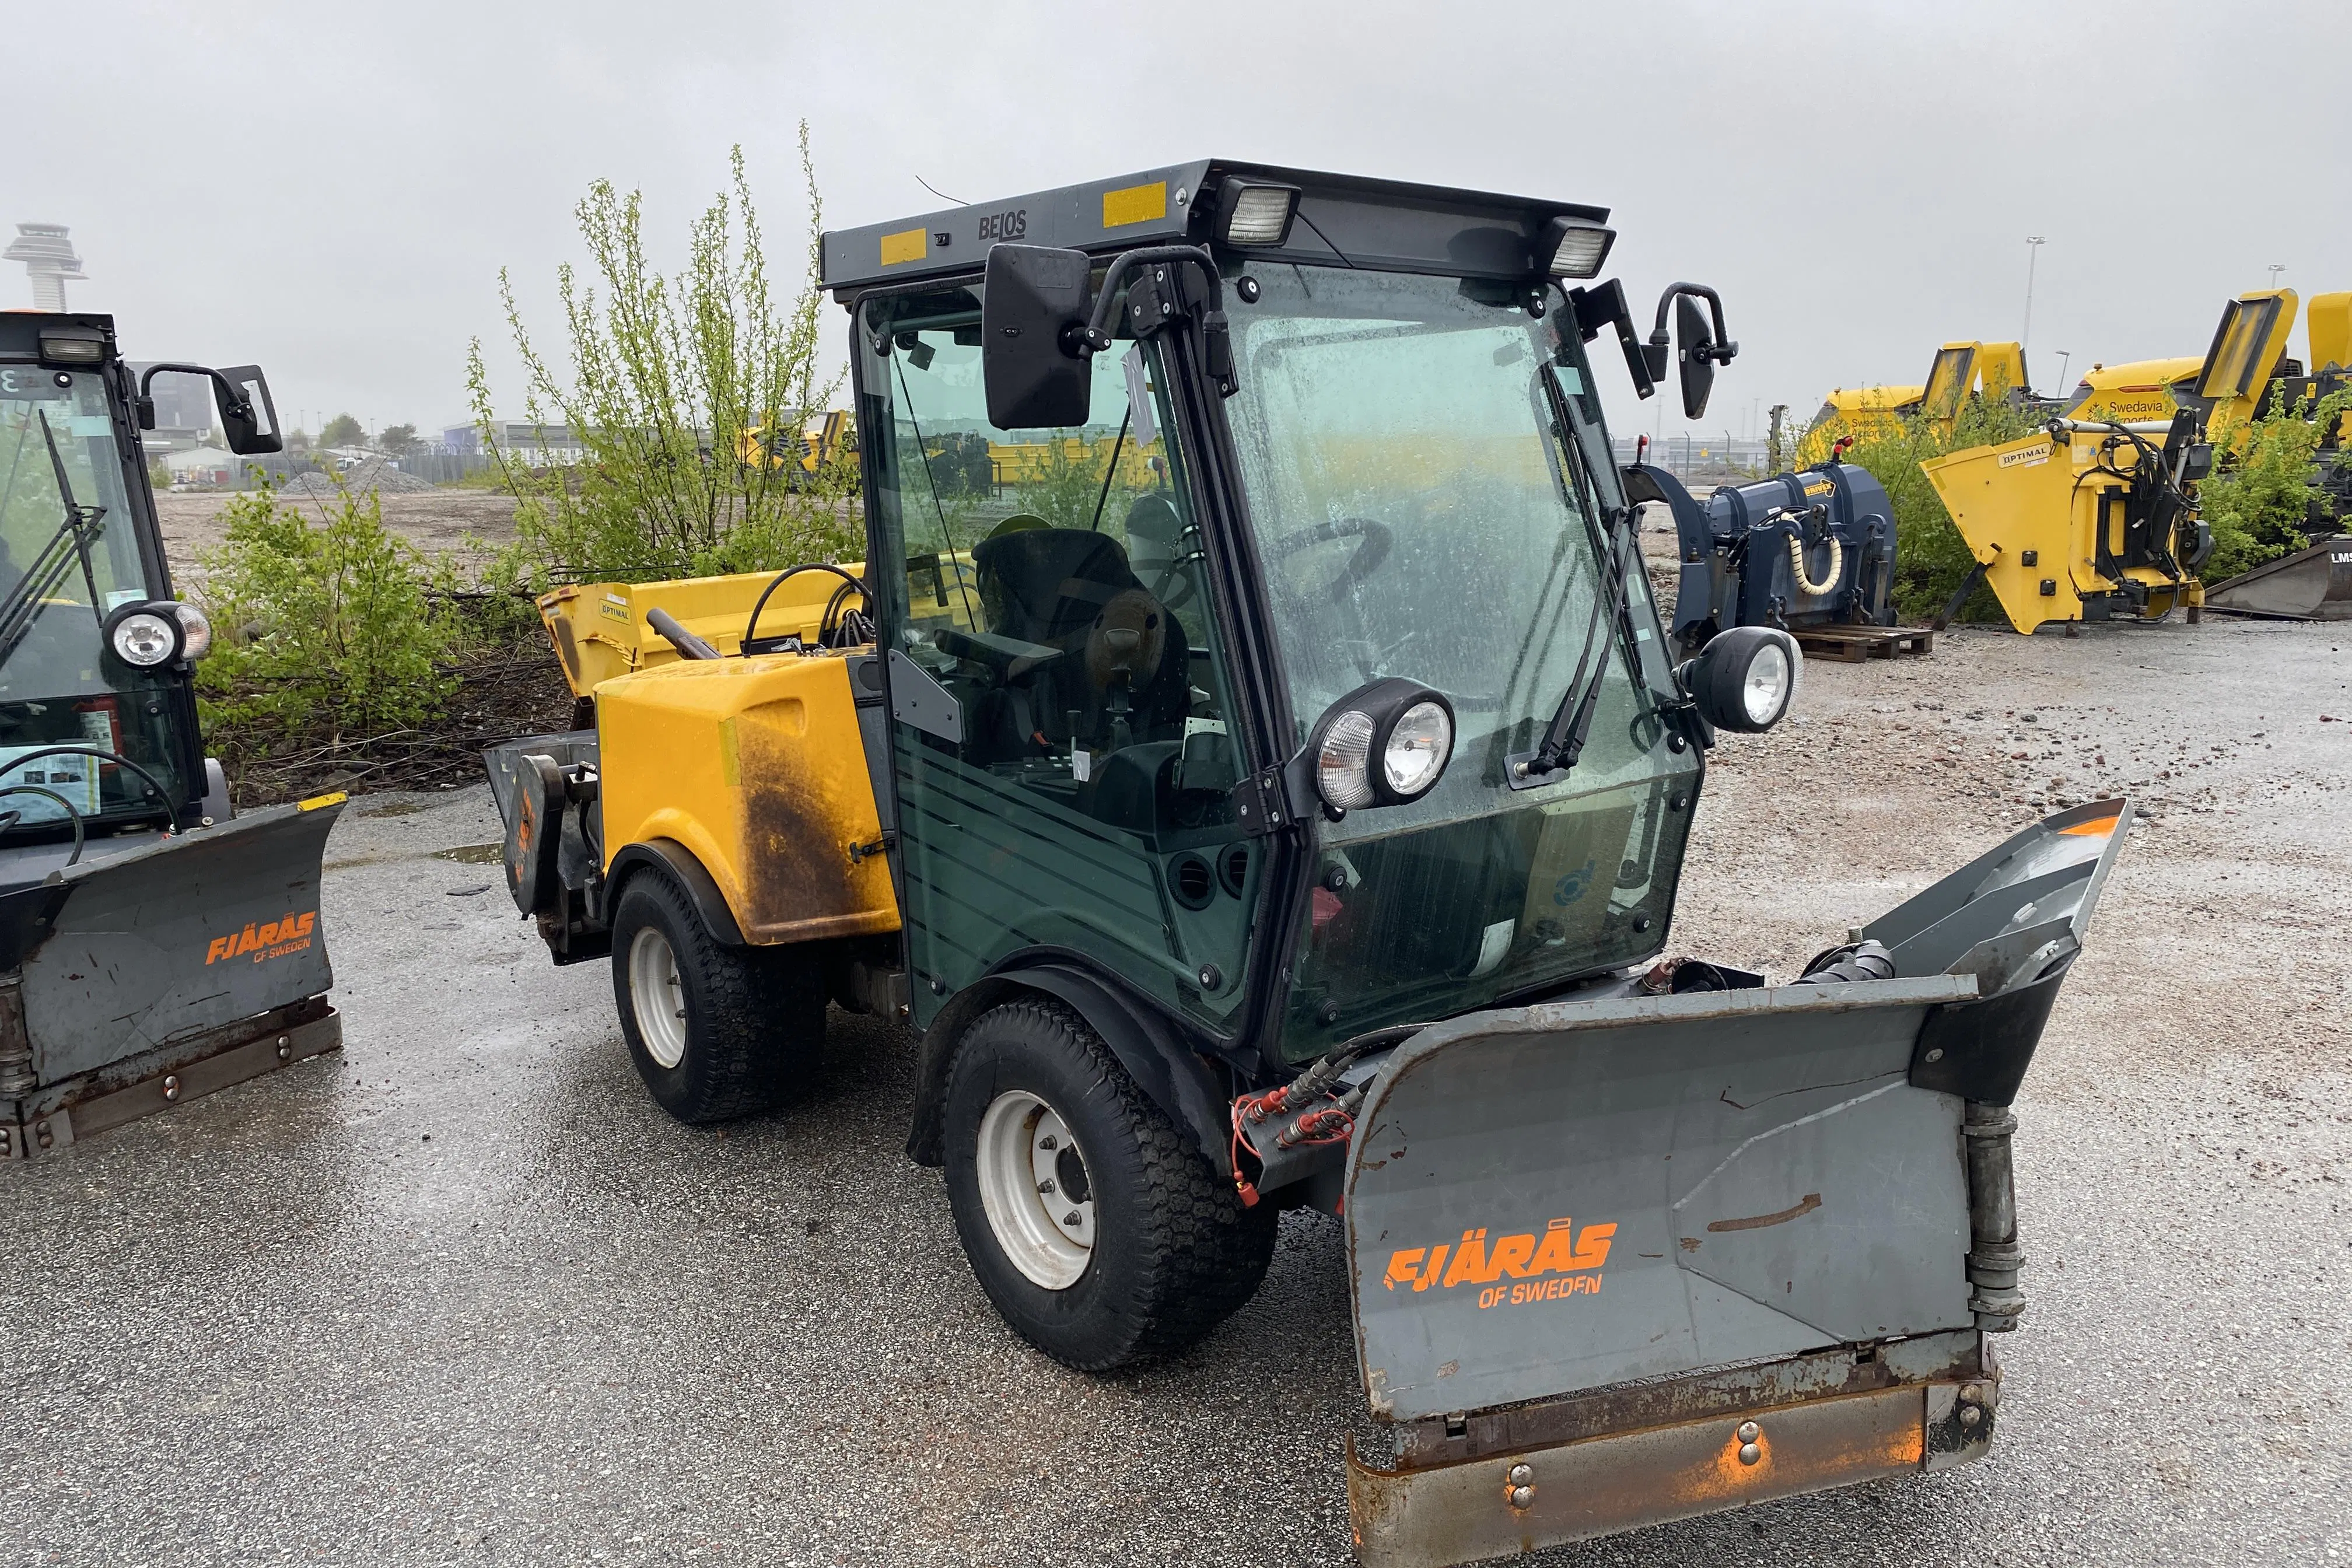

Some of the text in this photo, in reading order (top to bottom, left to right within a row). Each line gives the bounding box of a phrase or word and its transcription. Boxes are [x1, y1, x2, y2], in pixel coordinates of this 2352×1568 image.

[979, 209, 1027, 243] BELOS
[2110, 400, 2163, 412] Swedavia
[2003, 447, 2047, 466] OPTIMAL
[602, 604, 628, 620] OPTIMAL
[205, 911, 316, 965] FJÄRÅS
[268, 937, 311, 958] SWEDEN
[1479, 1286, 1508, 1309] OF
